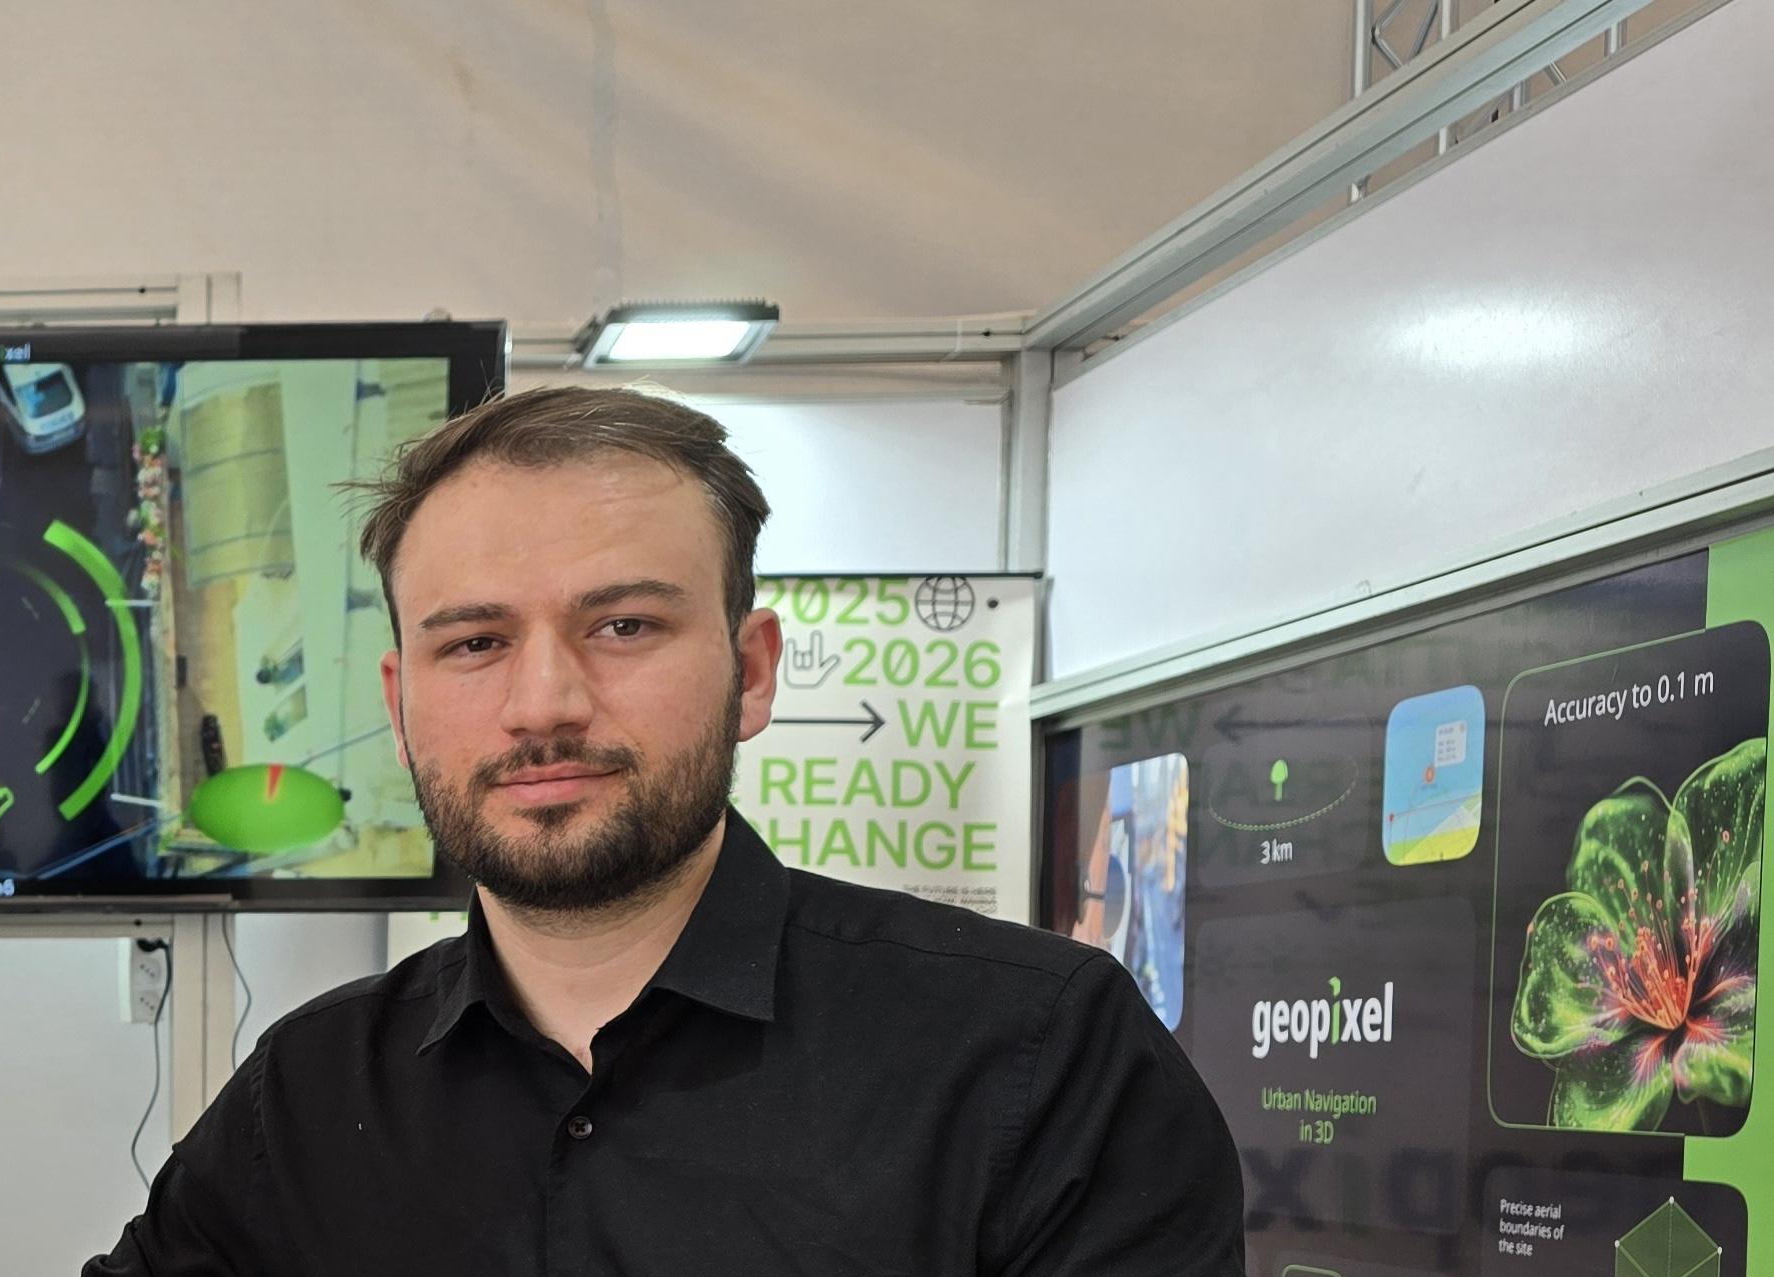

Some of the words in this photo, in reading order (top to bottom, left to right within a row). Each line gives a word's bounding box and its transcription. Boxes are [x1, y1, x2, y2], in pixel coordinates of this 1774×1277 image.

[842, 638, 1002, 689] 2026
[1543, 689, 1628, 727] Accuracy
[1631, 683, 1652, 709] to
[1657, 671, 1686, 704] 0.1
[1694, 670, 1715, 697] m
[897, 699, 999, 749] WE
[759, 756, 976, 810] READY
[753, 817, 998, 872] HANGE
[1260, 840, 1271, 865] 3
[1271, 838, 1293, 863] km
[1251, 975, 1395, 1060] geopixel
[1261, 1085, 1302, 1111] Urban
[1303, 1087, 1377, 1120] Navigation
[1298, 1118, 1313, 1144] in
[1313, 1119, 1335, 1145] 3D
[1499, 1217, 1552, 1240] boundaries
[1553, 1224, 1565, 1241] of
[1500, 1198, 1534, 1217] Precise
[1534, 1203, 1562, 1220] aerial
[1498, 1238, 1515, 1254] the
[1515, 1240, 1534, 1257] site
